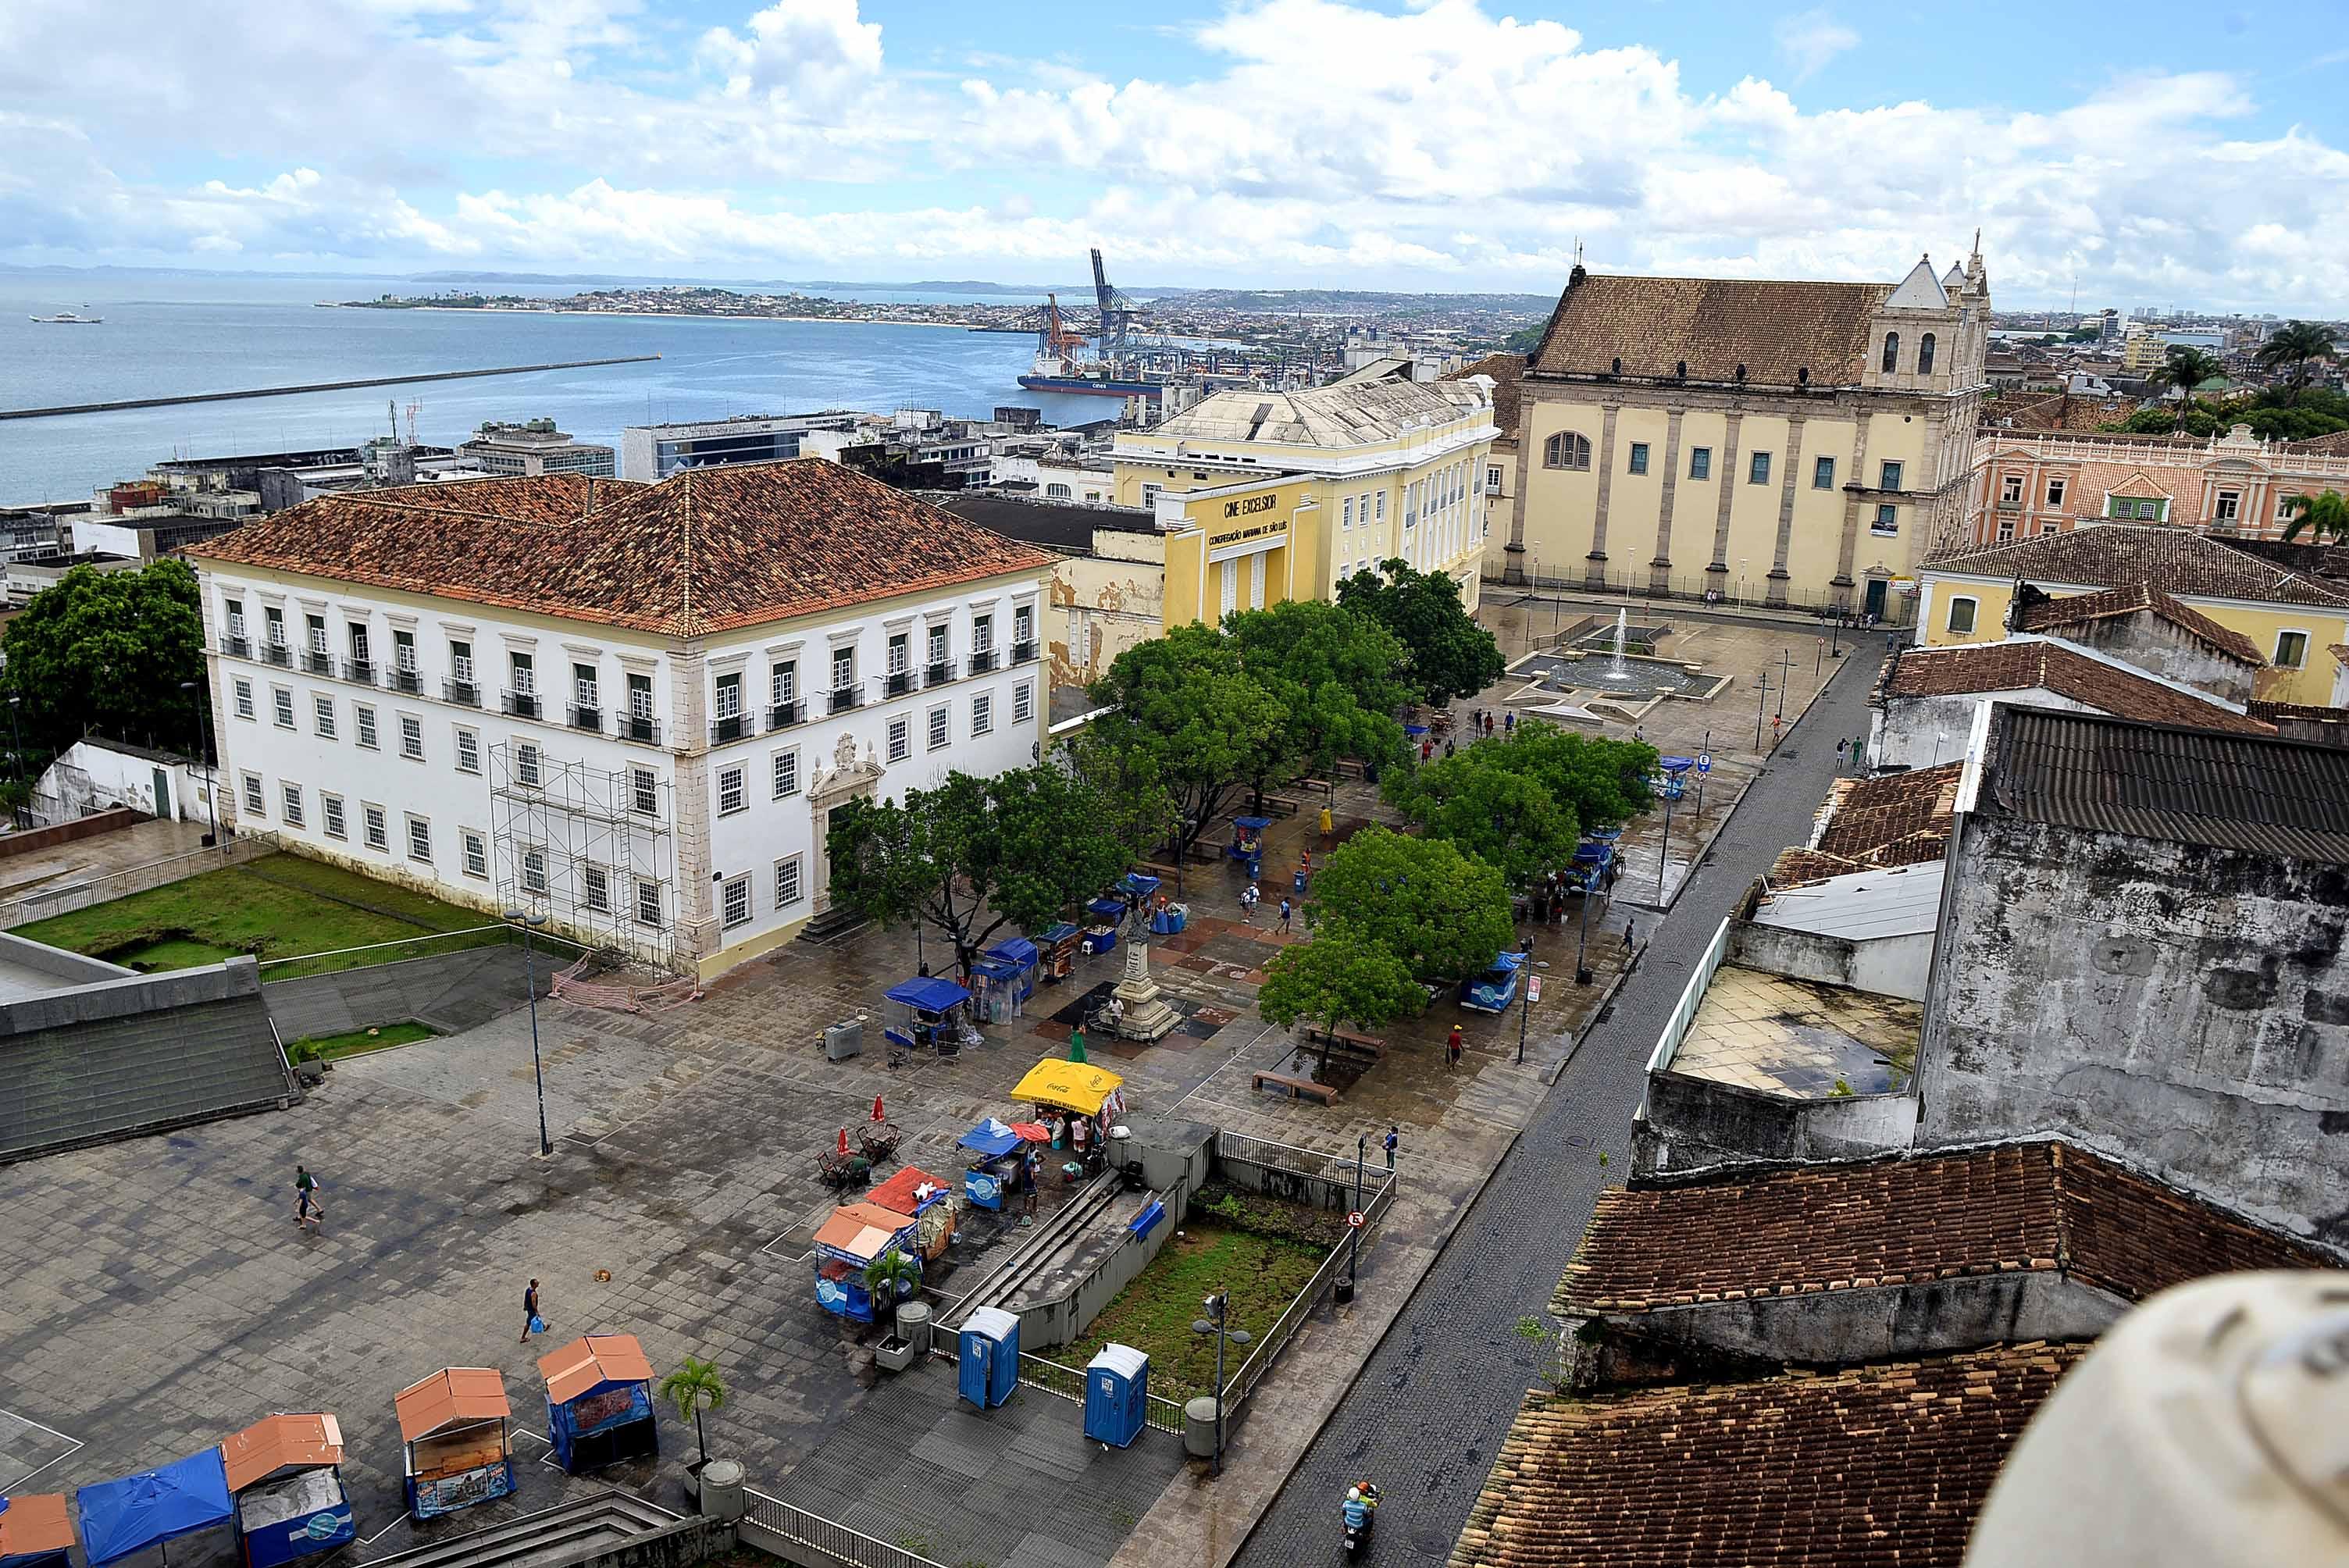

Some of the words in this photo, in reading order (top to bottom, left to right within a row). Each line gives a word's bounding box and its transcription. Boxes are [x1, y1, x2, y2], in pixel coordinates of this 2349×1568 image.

[1224, 501, 1239, 519] CINE
[1242, 494, 1276, 515] EXCELSIOR
[1209, 529, 1242, 545] CONGREGAÇÃO
[1243, 526, 1261, 538] MARIANA
[1262, 526, 1268, 534] DE
[1269, 522, 1278, 532] SÃO
